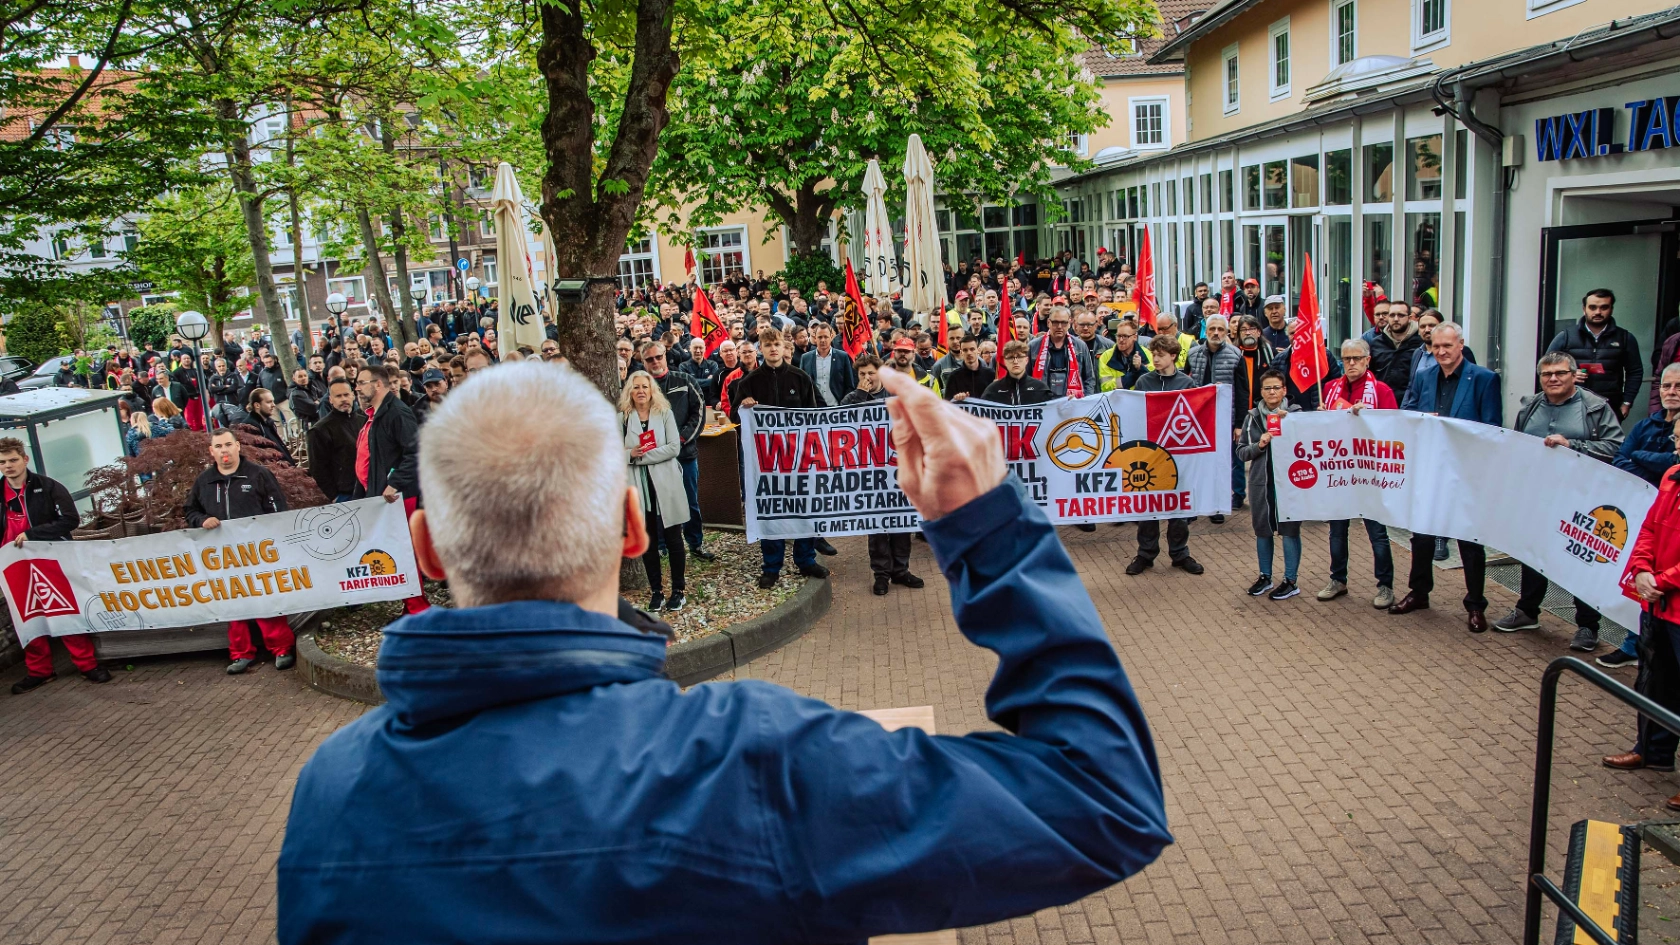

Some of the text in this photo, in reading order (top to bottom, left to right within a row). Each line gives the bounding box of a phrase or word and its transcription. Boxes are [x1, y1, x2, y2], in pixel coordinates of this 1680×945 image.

[1625, 97, 1680, 152] TA
[754, 410, 860, 427] VOLKSWAGEN
[1294, 438, 1405, 461] 6,5 % MEHR
[1132, 473, 1146, 482] HU
[1320, 459, 1354, 471] NÖTIG
[1376, 462, 1405, 474] FAIR!
[756, 474, 809, 496] ALLE
[815, 468, 888, 495] RÄDER
[1075, 472, 1118, 493] KFZ
[1327, 474, 1348, 488] Ich
[1351, 474, 1369, 485] bin
[756, 491, 914, 515] WENN DEIN STARK
[1055, 491, 1191, 517] TARIFRUNDE
[814, 521, 827, 533] IG
[830, 518, 879, 532] METALL
[1572, 511, 1595, 531] KFZ
[1560, 520, 1620, 563] TARIFRUNDE
[1566, 540, 1595, 563] 2025
[110, 538, 280, 584] EINEN GANG
[346, 565, 369, 578] KFZ
[100, 565, 313, 612] HOCHSCHALTEN
[339, 573, 407, 591] TARIFRUNDE
